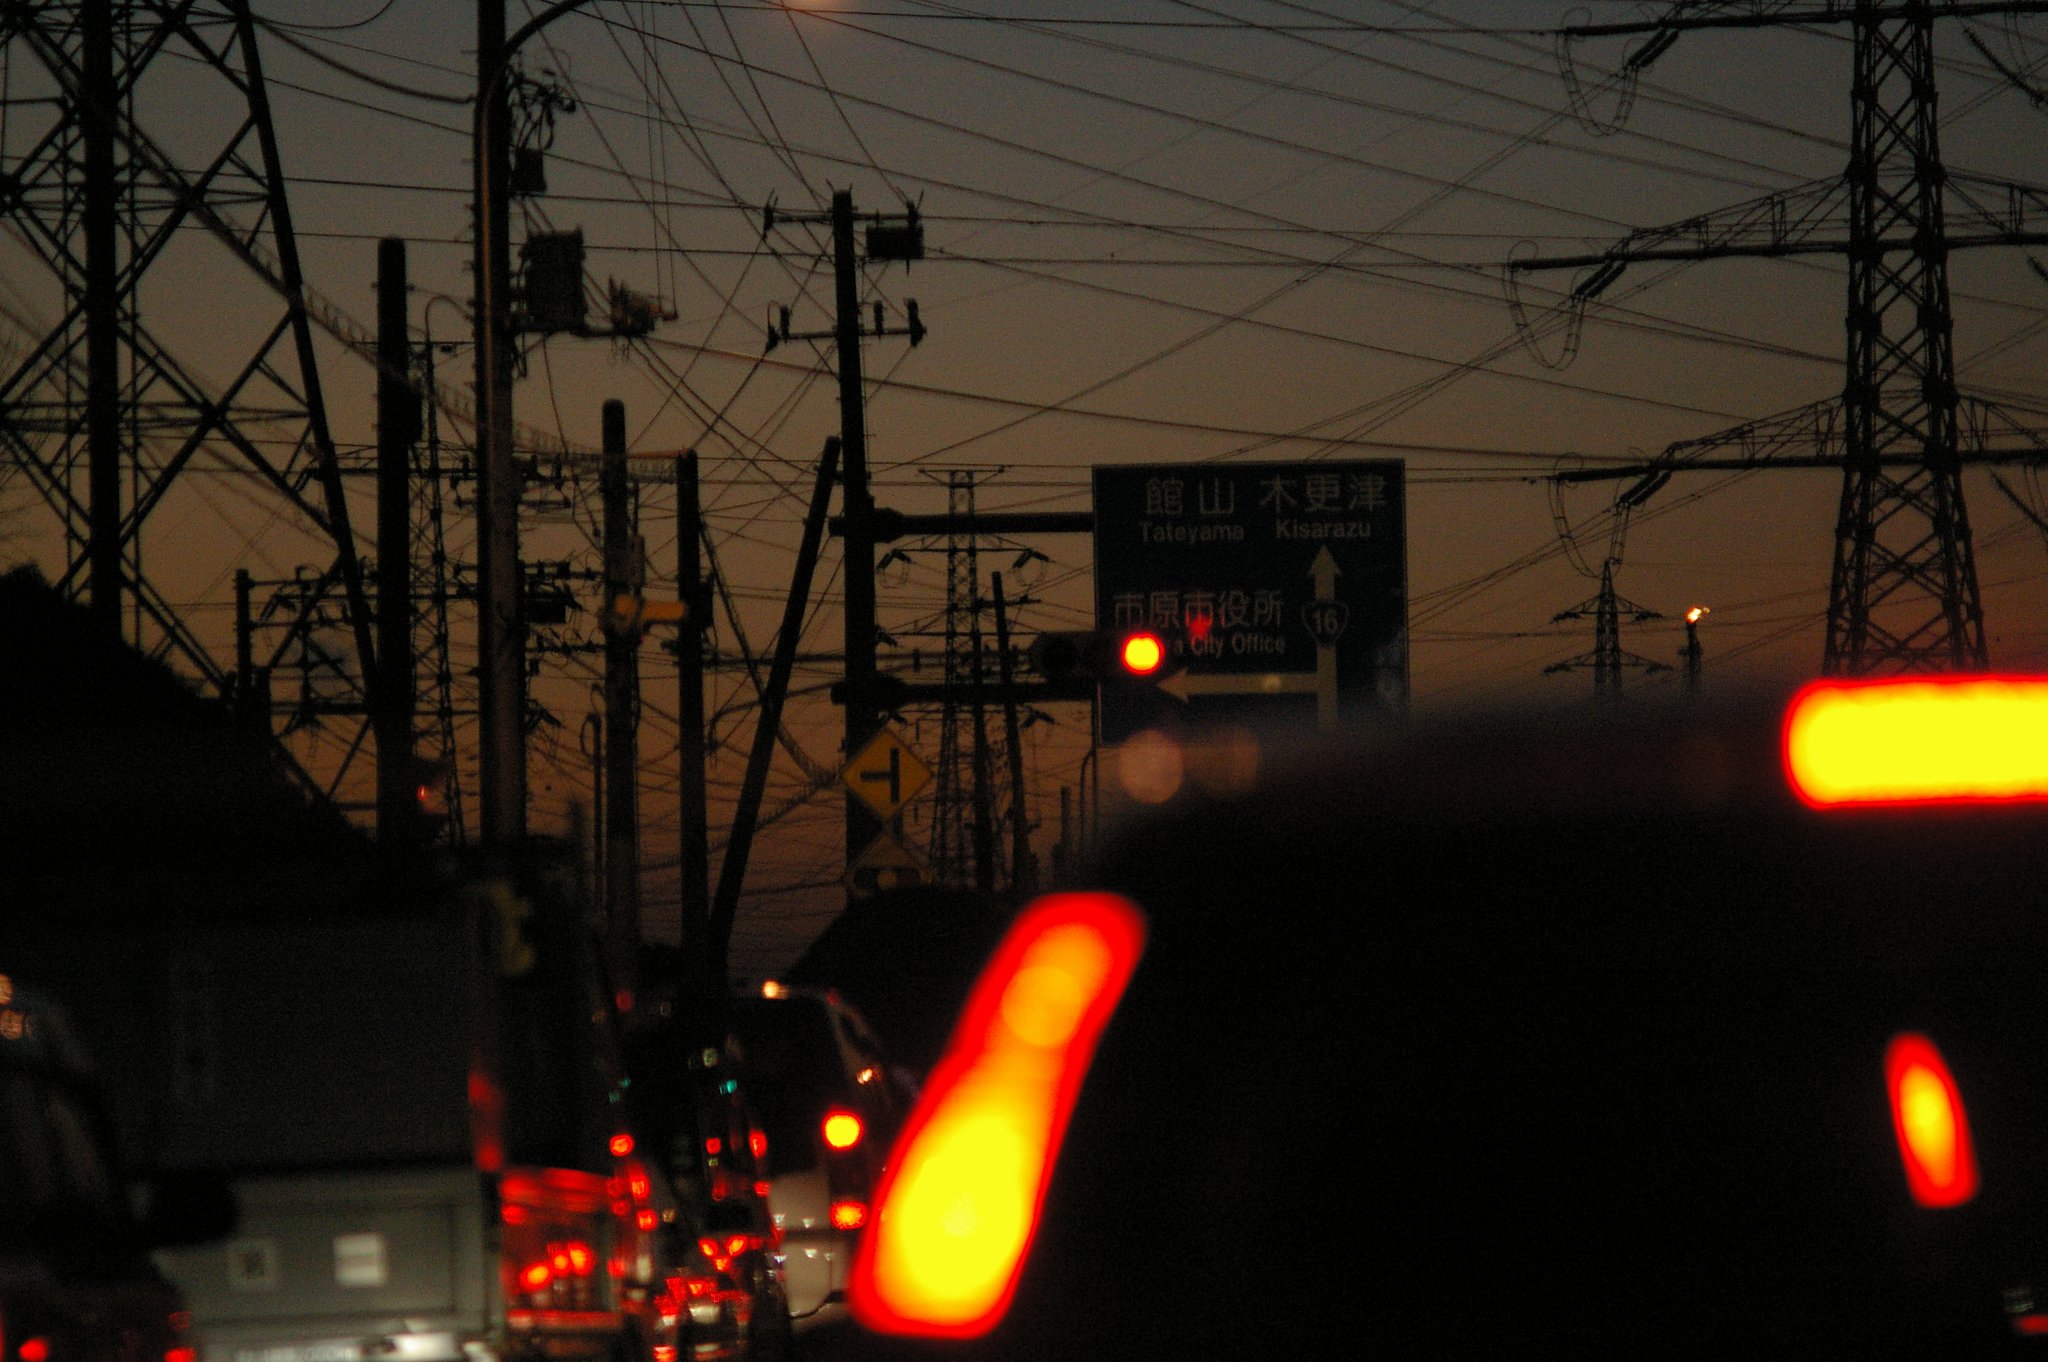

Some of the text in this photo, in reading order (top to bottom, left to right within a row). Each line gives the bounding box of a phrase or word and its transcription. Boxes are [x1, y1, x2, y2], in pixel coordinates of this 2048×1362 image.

[1146, 477, 1235, 515] 館山
[1259, 474, 1387, 513] 木更津
[1141, 521, 1245, 543] Tateyama
[1275, 519, 1372, 539] Kisarazu
[1113, 589, 1285, 629] 市原市役所
[1314, 609, 1340, 632] 16
[1191, 635, 1225, 658] City
[1231, 633, 1287, 656] Office
